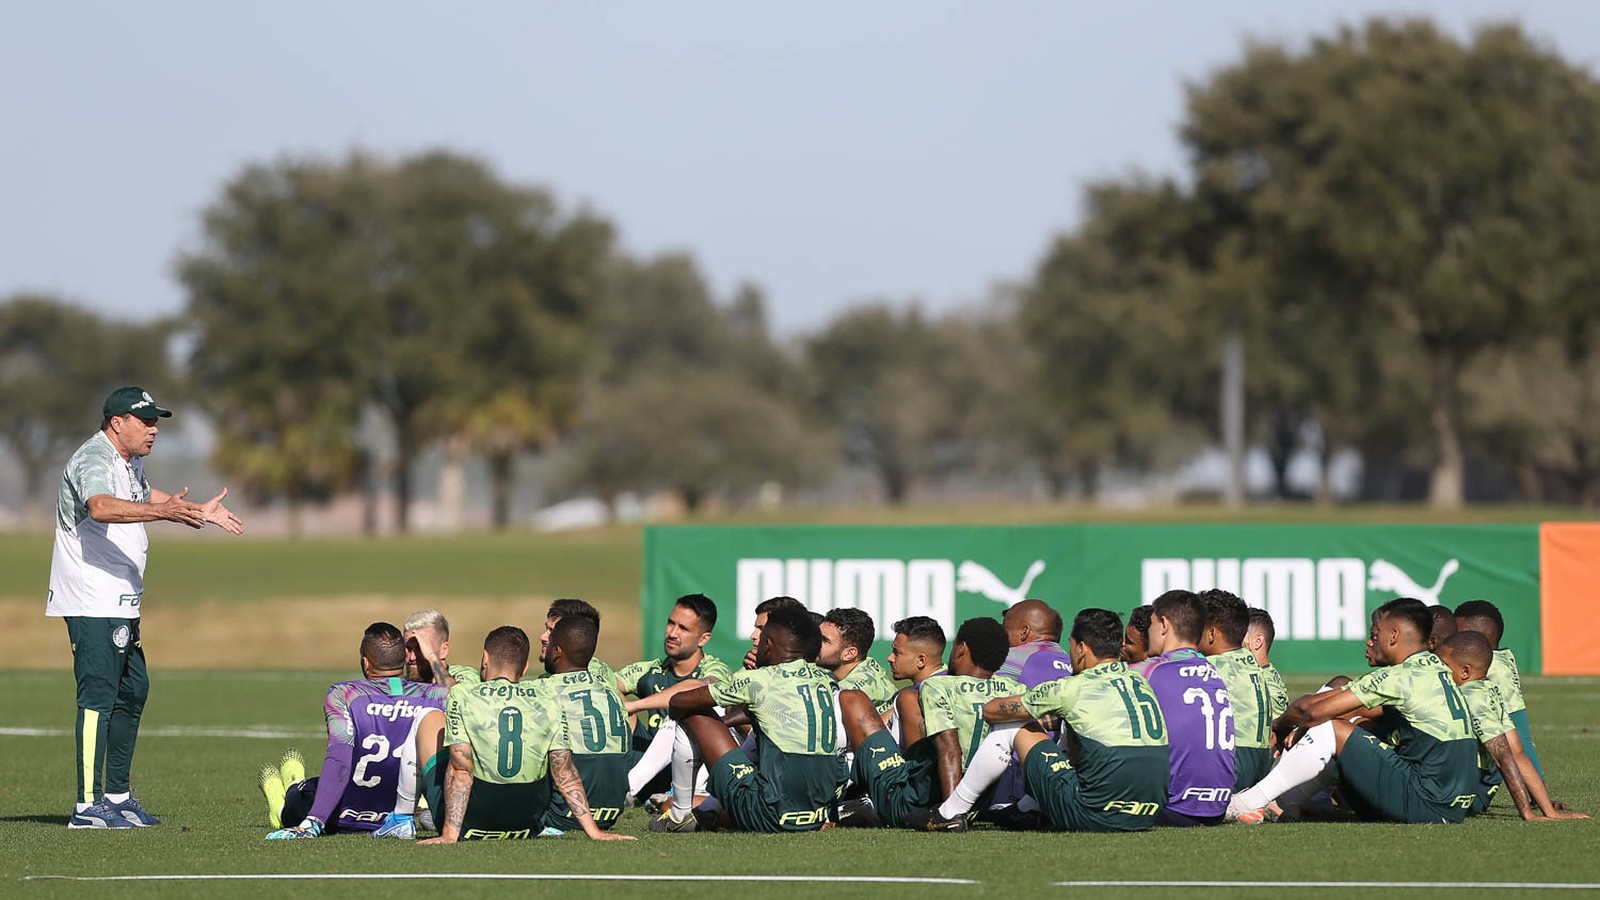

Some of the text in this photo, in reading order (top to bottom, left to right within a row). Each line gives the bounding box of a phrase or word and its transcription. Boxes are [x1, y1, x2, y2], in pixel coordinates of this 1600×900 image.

[736, 558, 957, 640] PUMA
[479, 685, 537, 701] crefisa
[568, 689, 628, 753] 34
[796, 684, 837, 753] 18
[1110, 675, 1164, 741] 15
[1438, 671, 1470, 736] 4
[496, 706, 523, 779] 8
